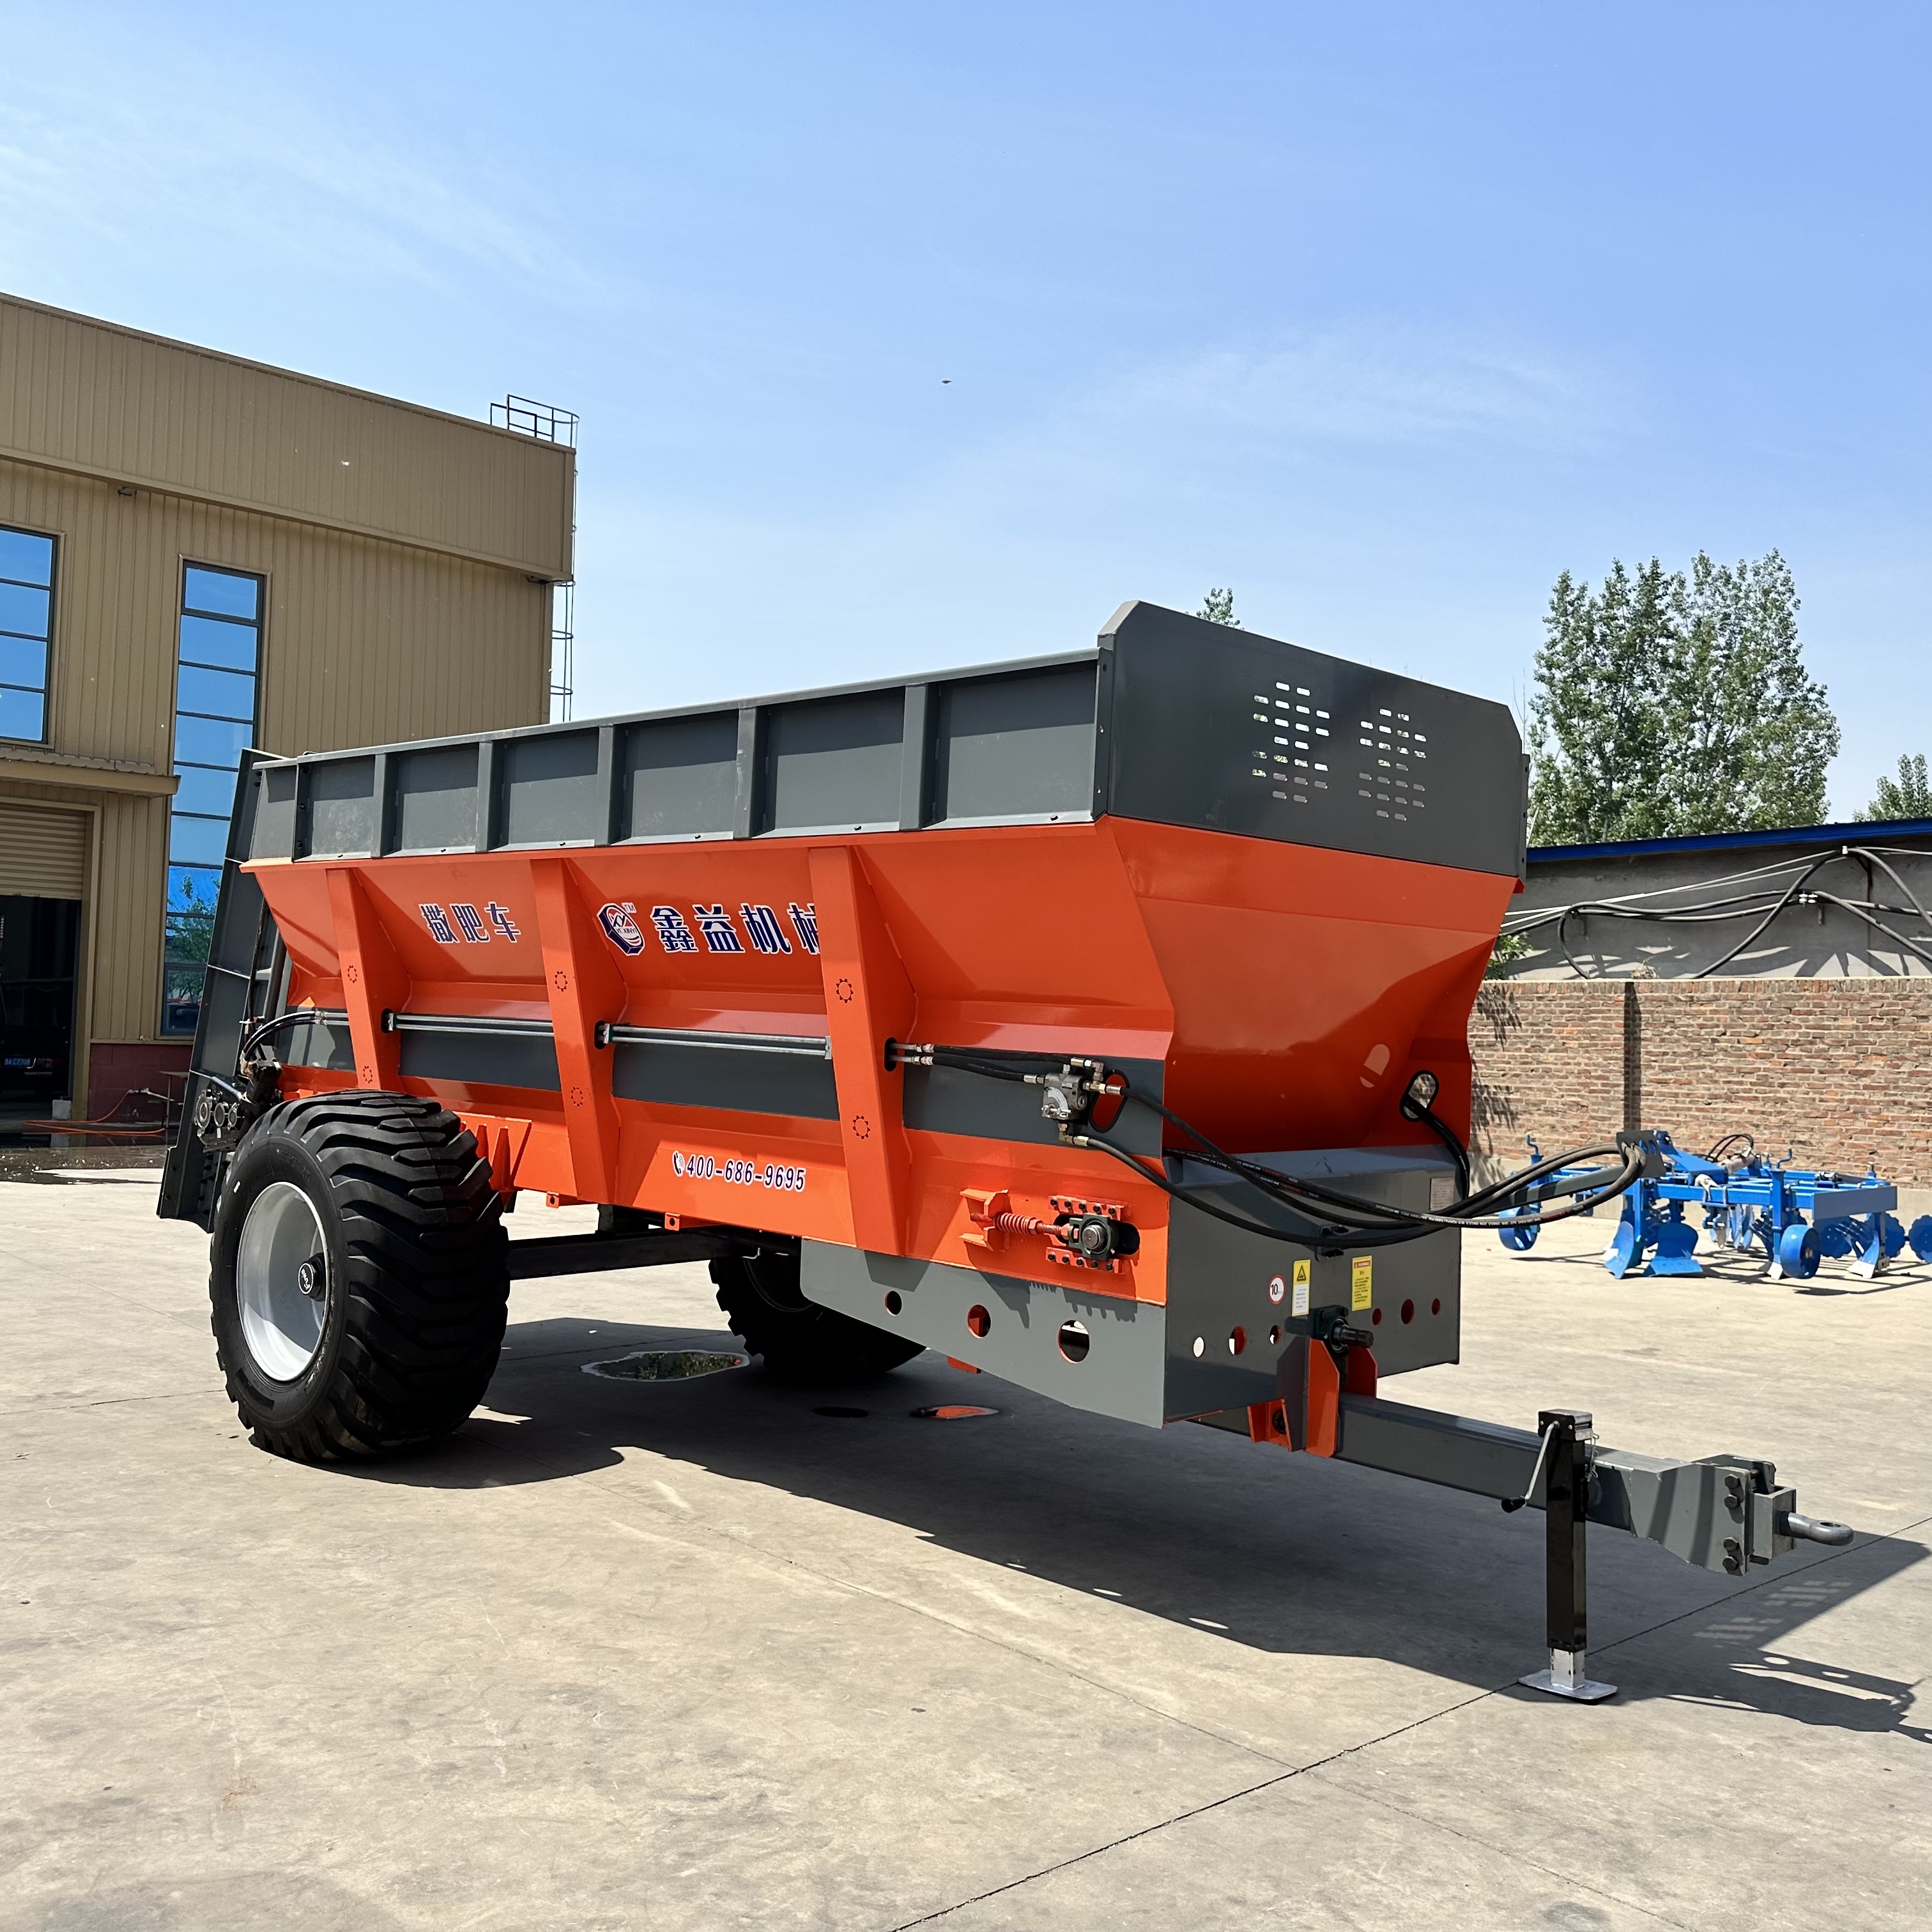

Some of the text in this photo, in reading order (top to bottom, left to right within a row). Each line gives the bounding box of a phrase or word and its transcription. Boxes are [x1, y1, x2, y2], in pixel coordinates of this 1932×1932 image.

[419, 902, 521, 942] 撒肥车
[686, 1154, 805, 1191] 400-686-9695
[1271, 1284, 1278, 1295] 10
